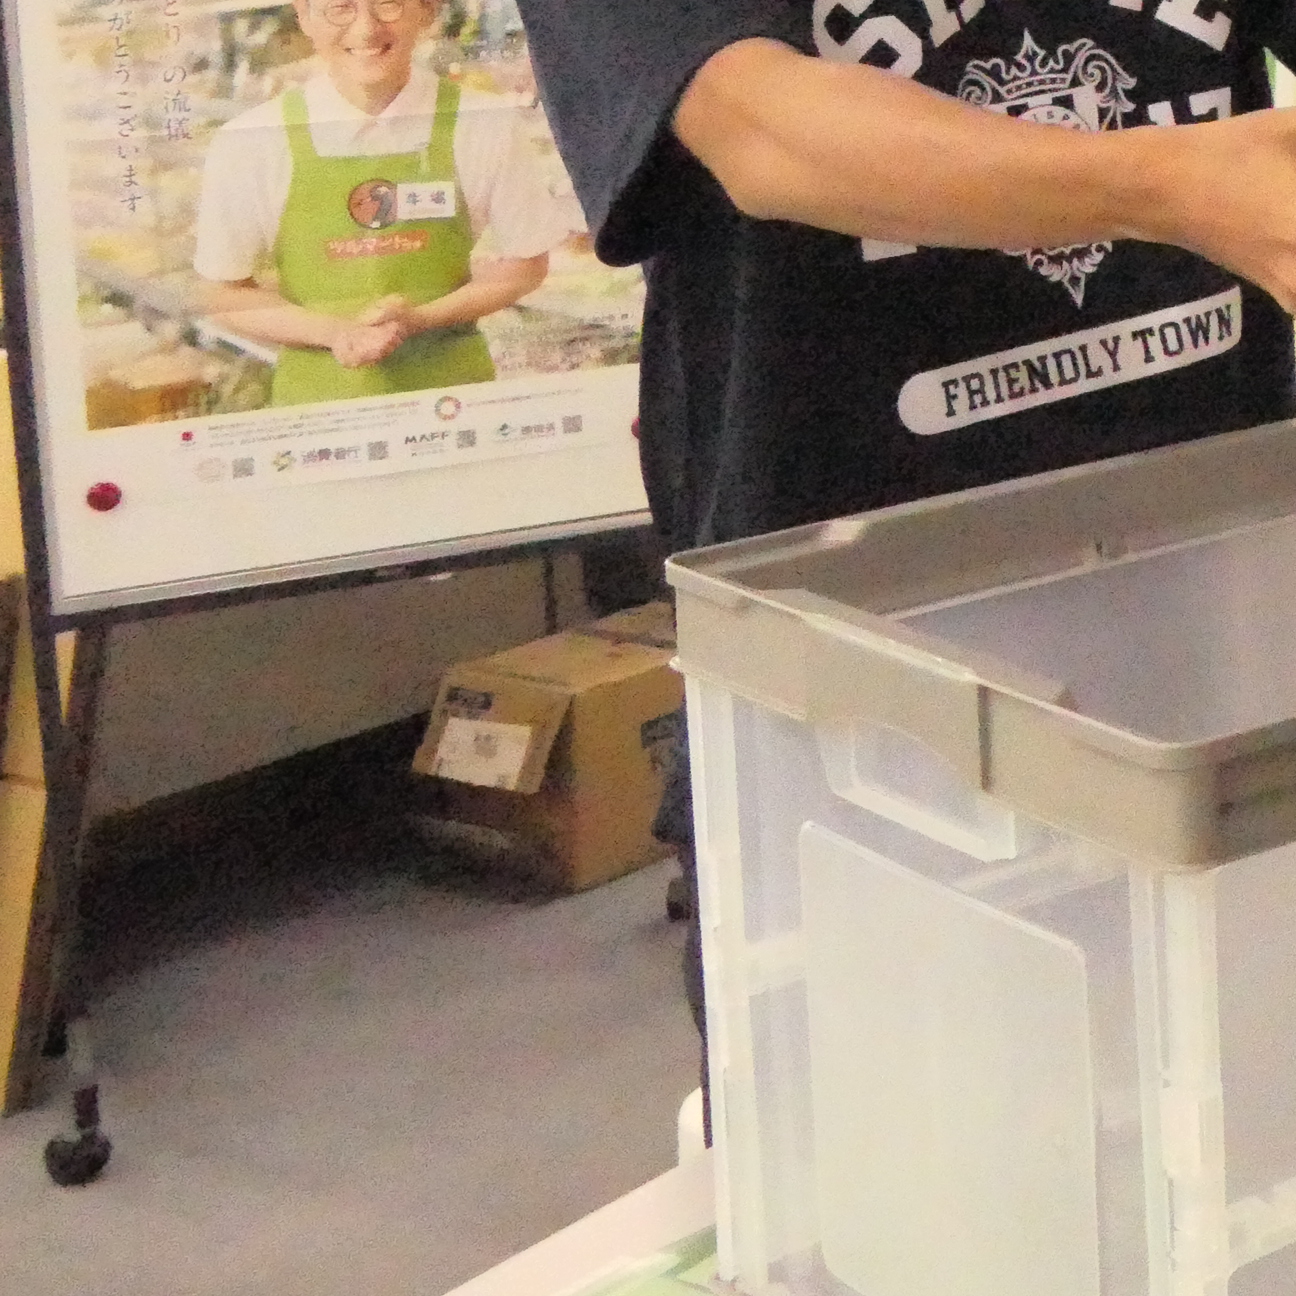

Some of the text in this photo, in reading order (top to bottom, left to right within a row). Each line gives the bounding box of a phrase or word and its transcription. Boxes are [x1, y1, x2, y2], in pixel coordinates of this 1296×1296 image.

[943, 303, 1237, 418] FRIENDLY TOWN
[404, 431, 450, 446] MAFF
